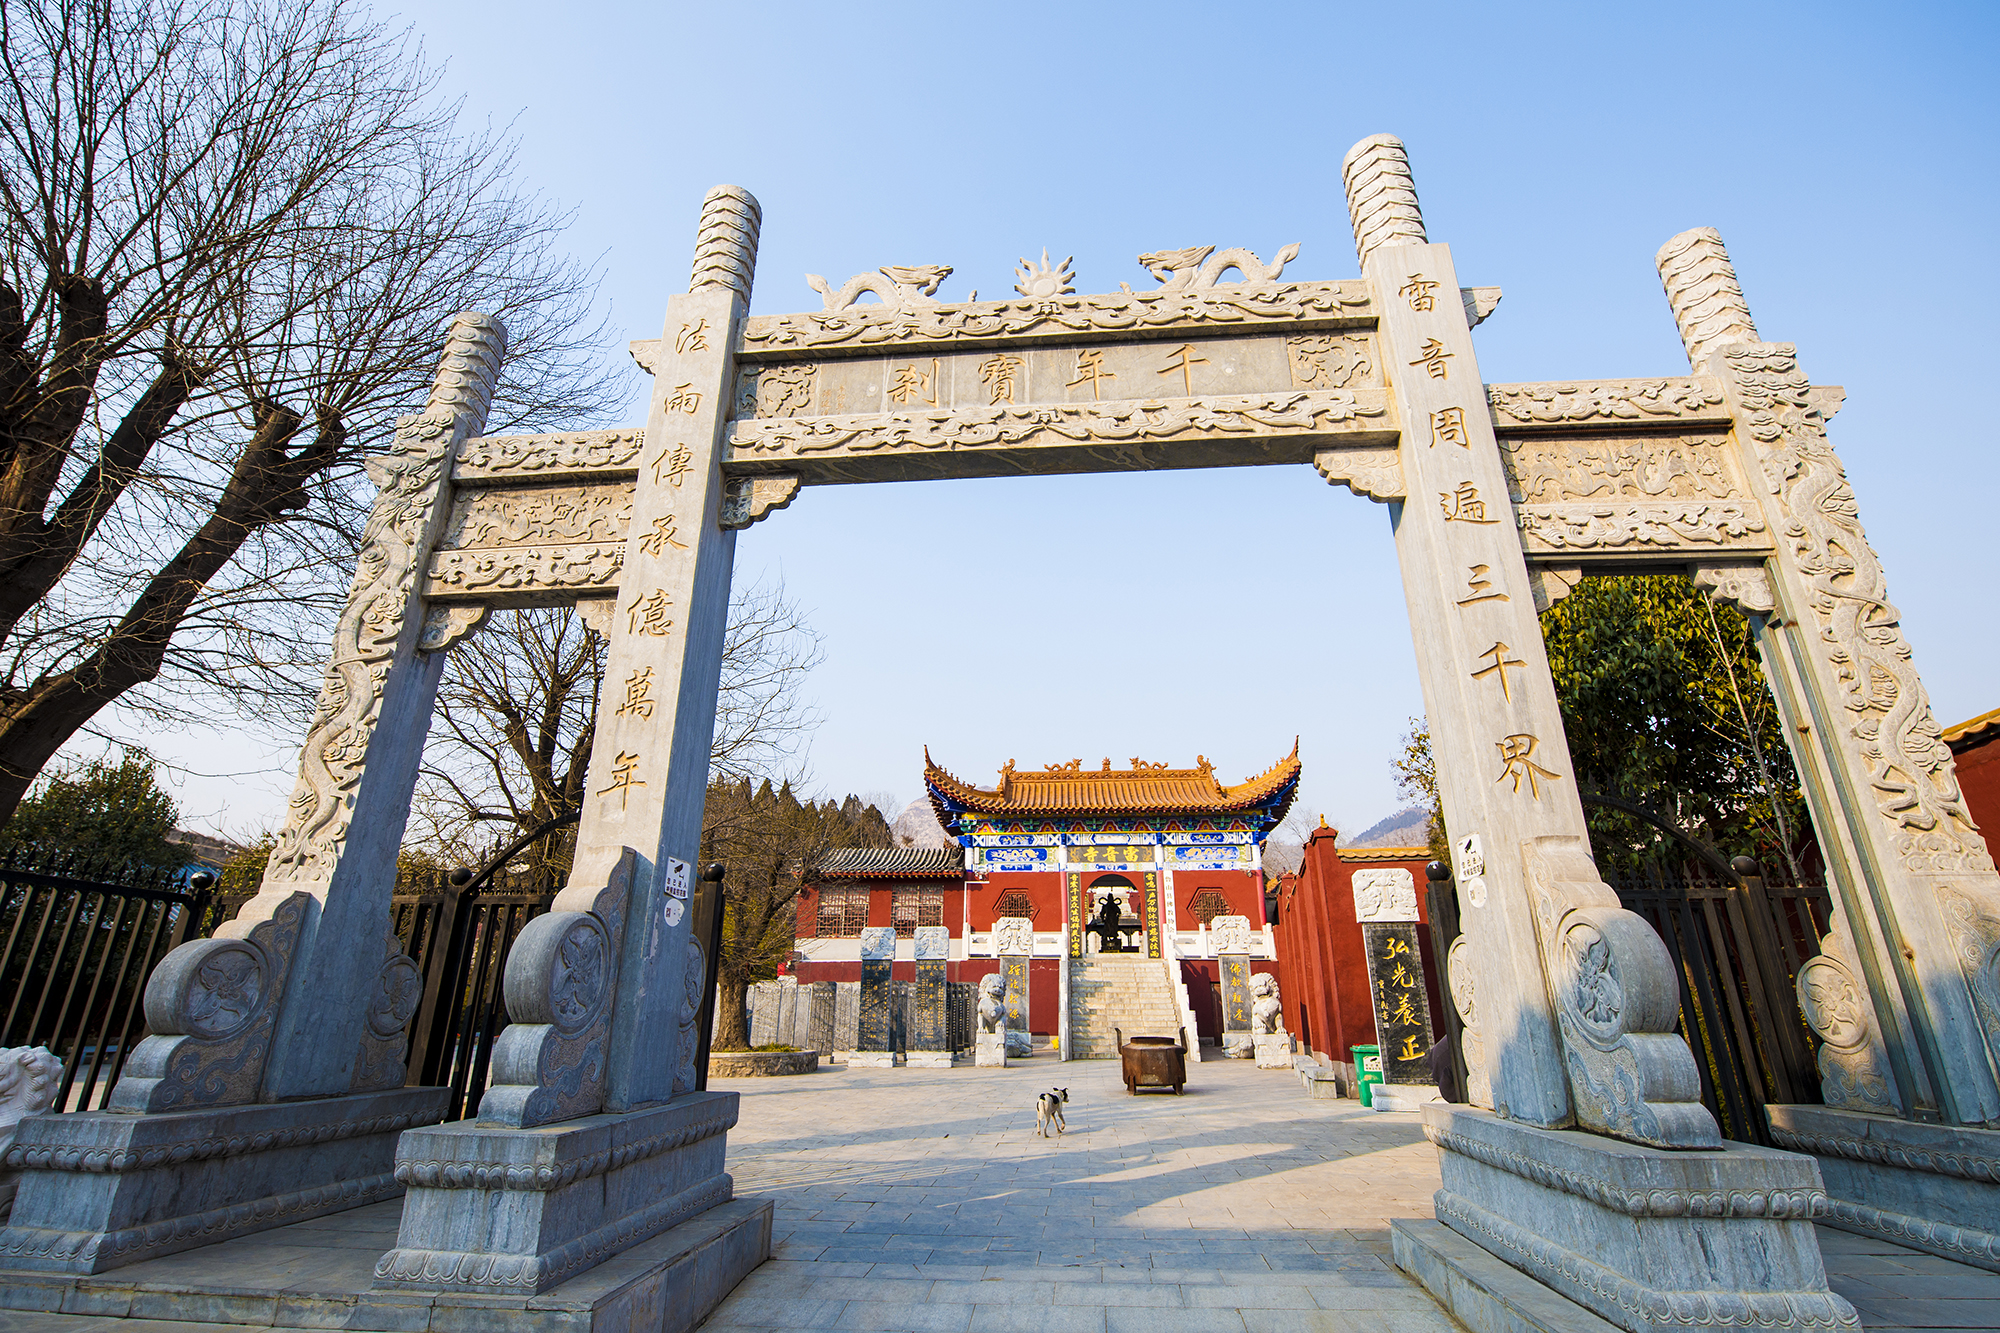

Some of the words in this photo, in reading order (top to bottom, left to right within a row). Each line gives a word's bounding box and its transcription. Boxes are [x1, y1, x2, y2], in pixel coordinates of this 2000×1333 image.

[597, 316, 711, 812] 法雨傳承億萬年
[1398, 273, 1562, 801] 雷音周遍三千界
